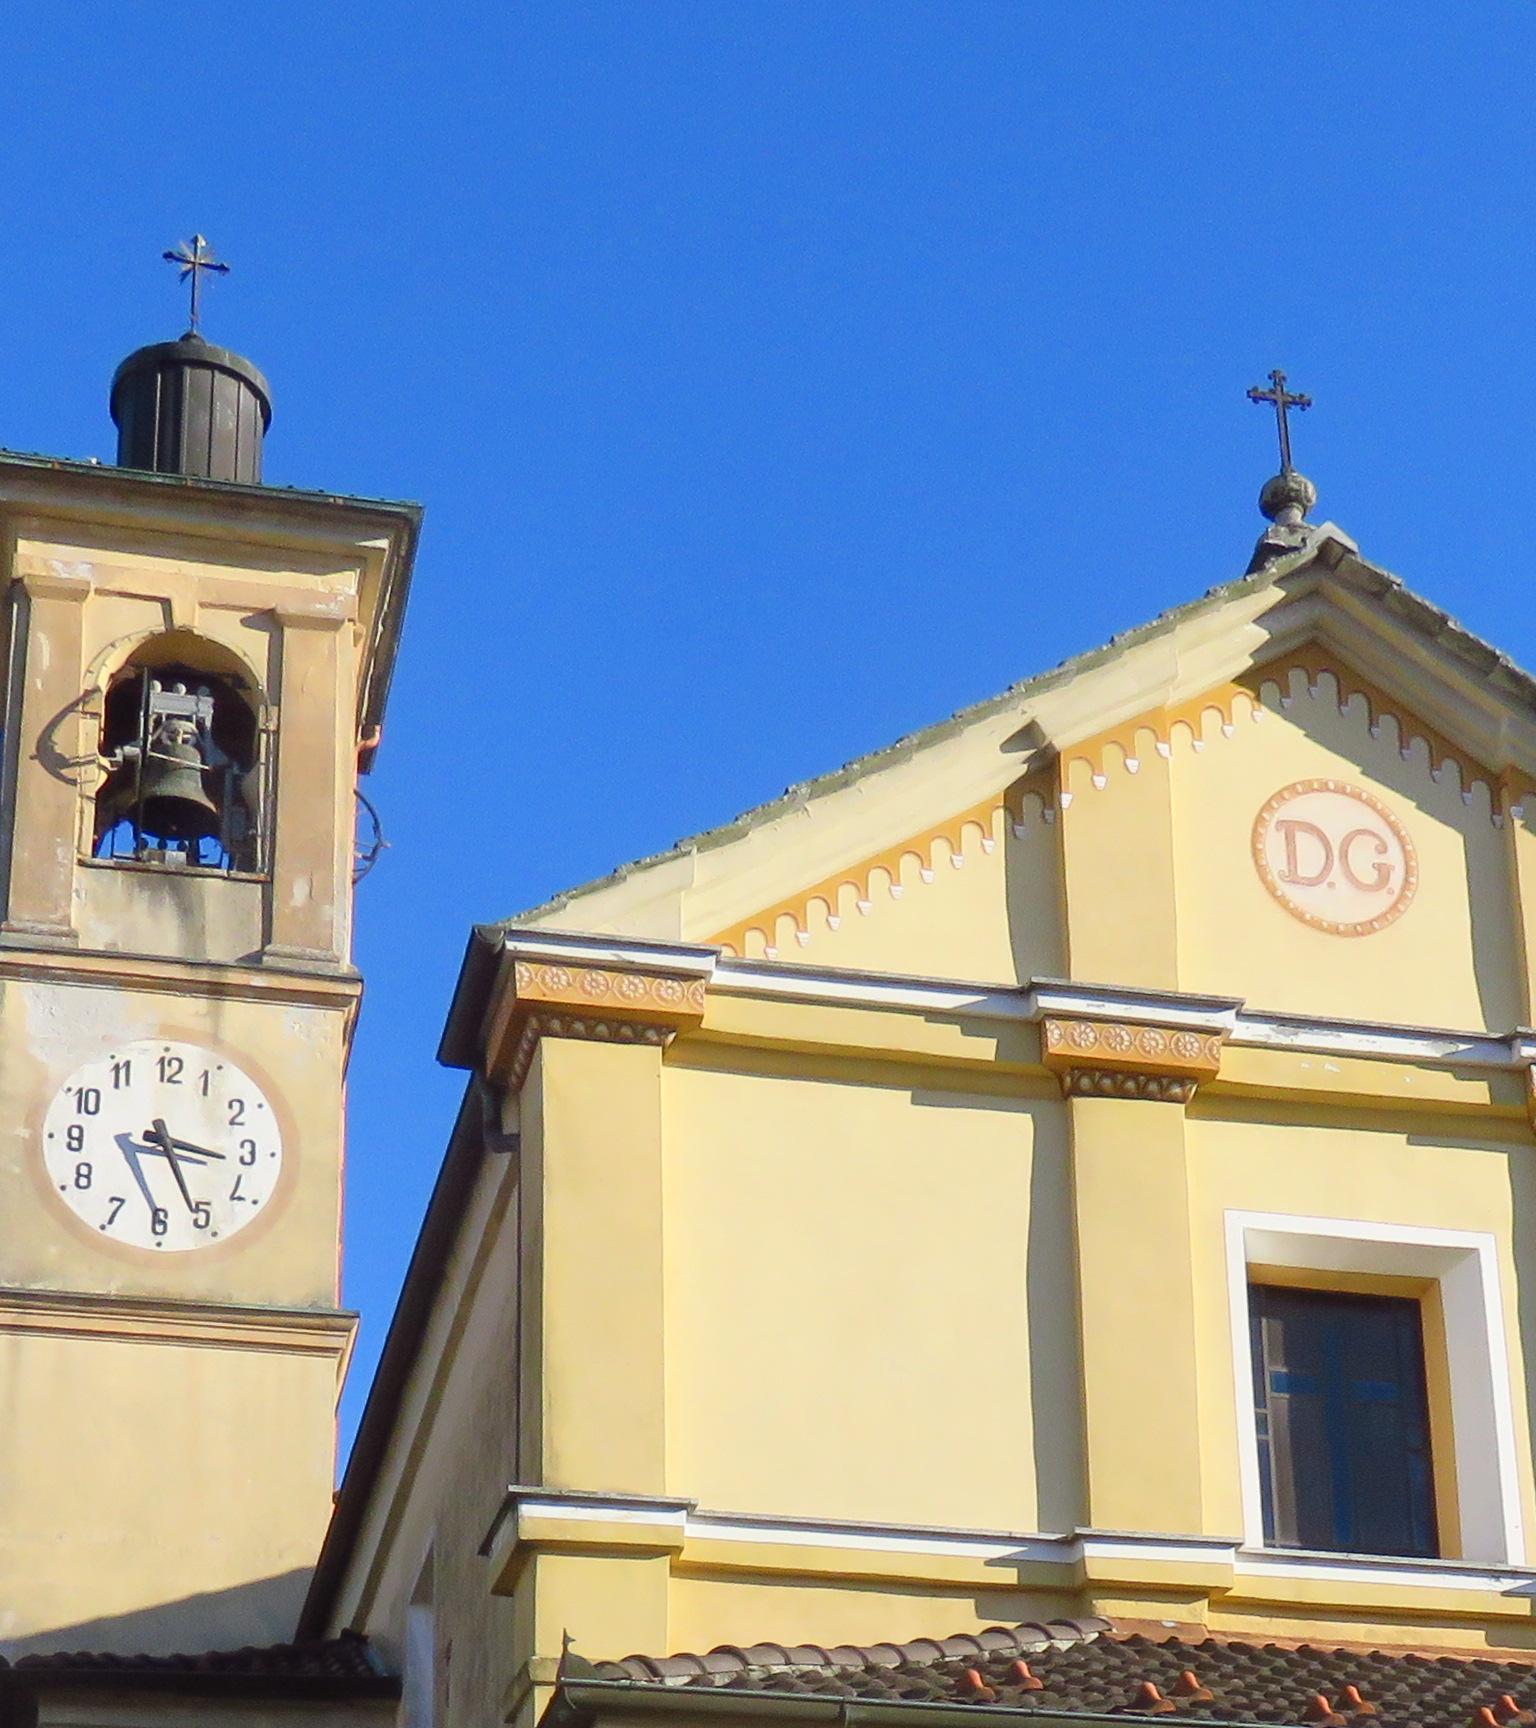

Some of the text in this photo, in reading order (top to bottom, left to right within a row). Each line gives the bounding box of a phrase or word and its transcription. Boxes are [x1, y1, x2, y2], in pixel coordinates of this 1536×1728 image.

[110, 1060, 131, 1089] 11
[156, 1056, 184, 1084] 12
[198, 1070, 209, 1096] 1
[72, 1087, 101, 1115] 10
[228, 1099, 245, 1126] 2
[66, 1124, 84, 1152] 9
[239, 1139, 256, 1166] 3
[74, 1162, 92, 1189] 8
[107, 1197, 126, 1225] 7
[151, 1208, 168, 1236] 6
[192, 1200, 212, 1229] 5
